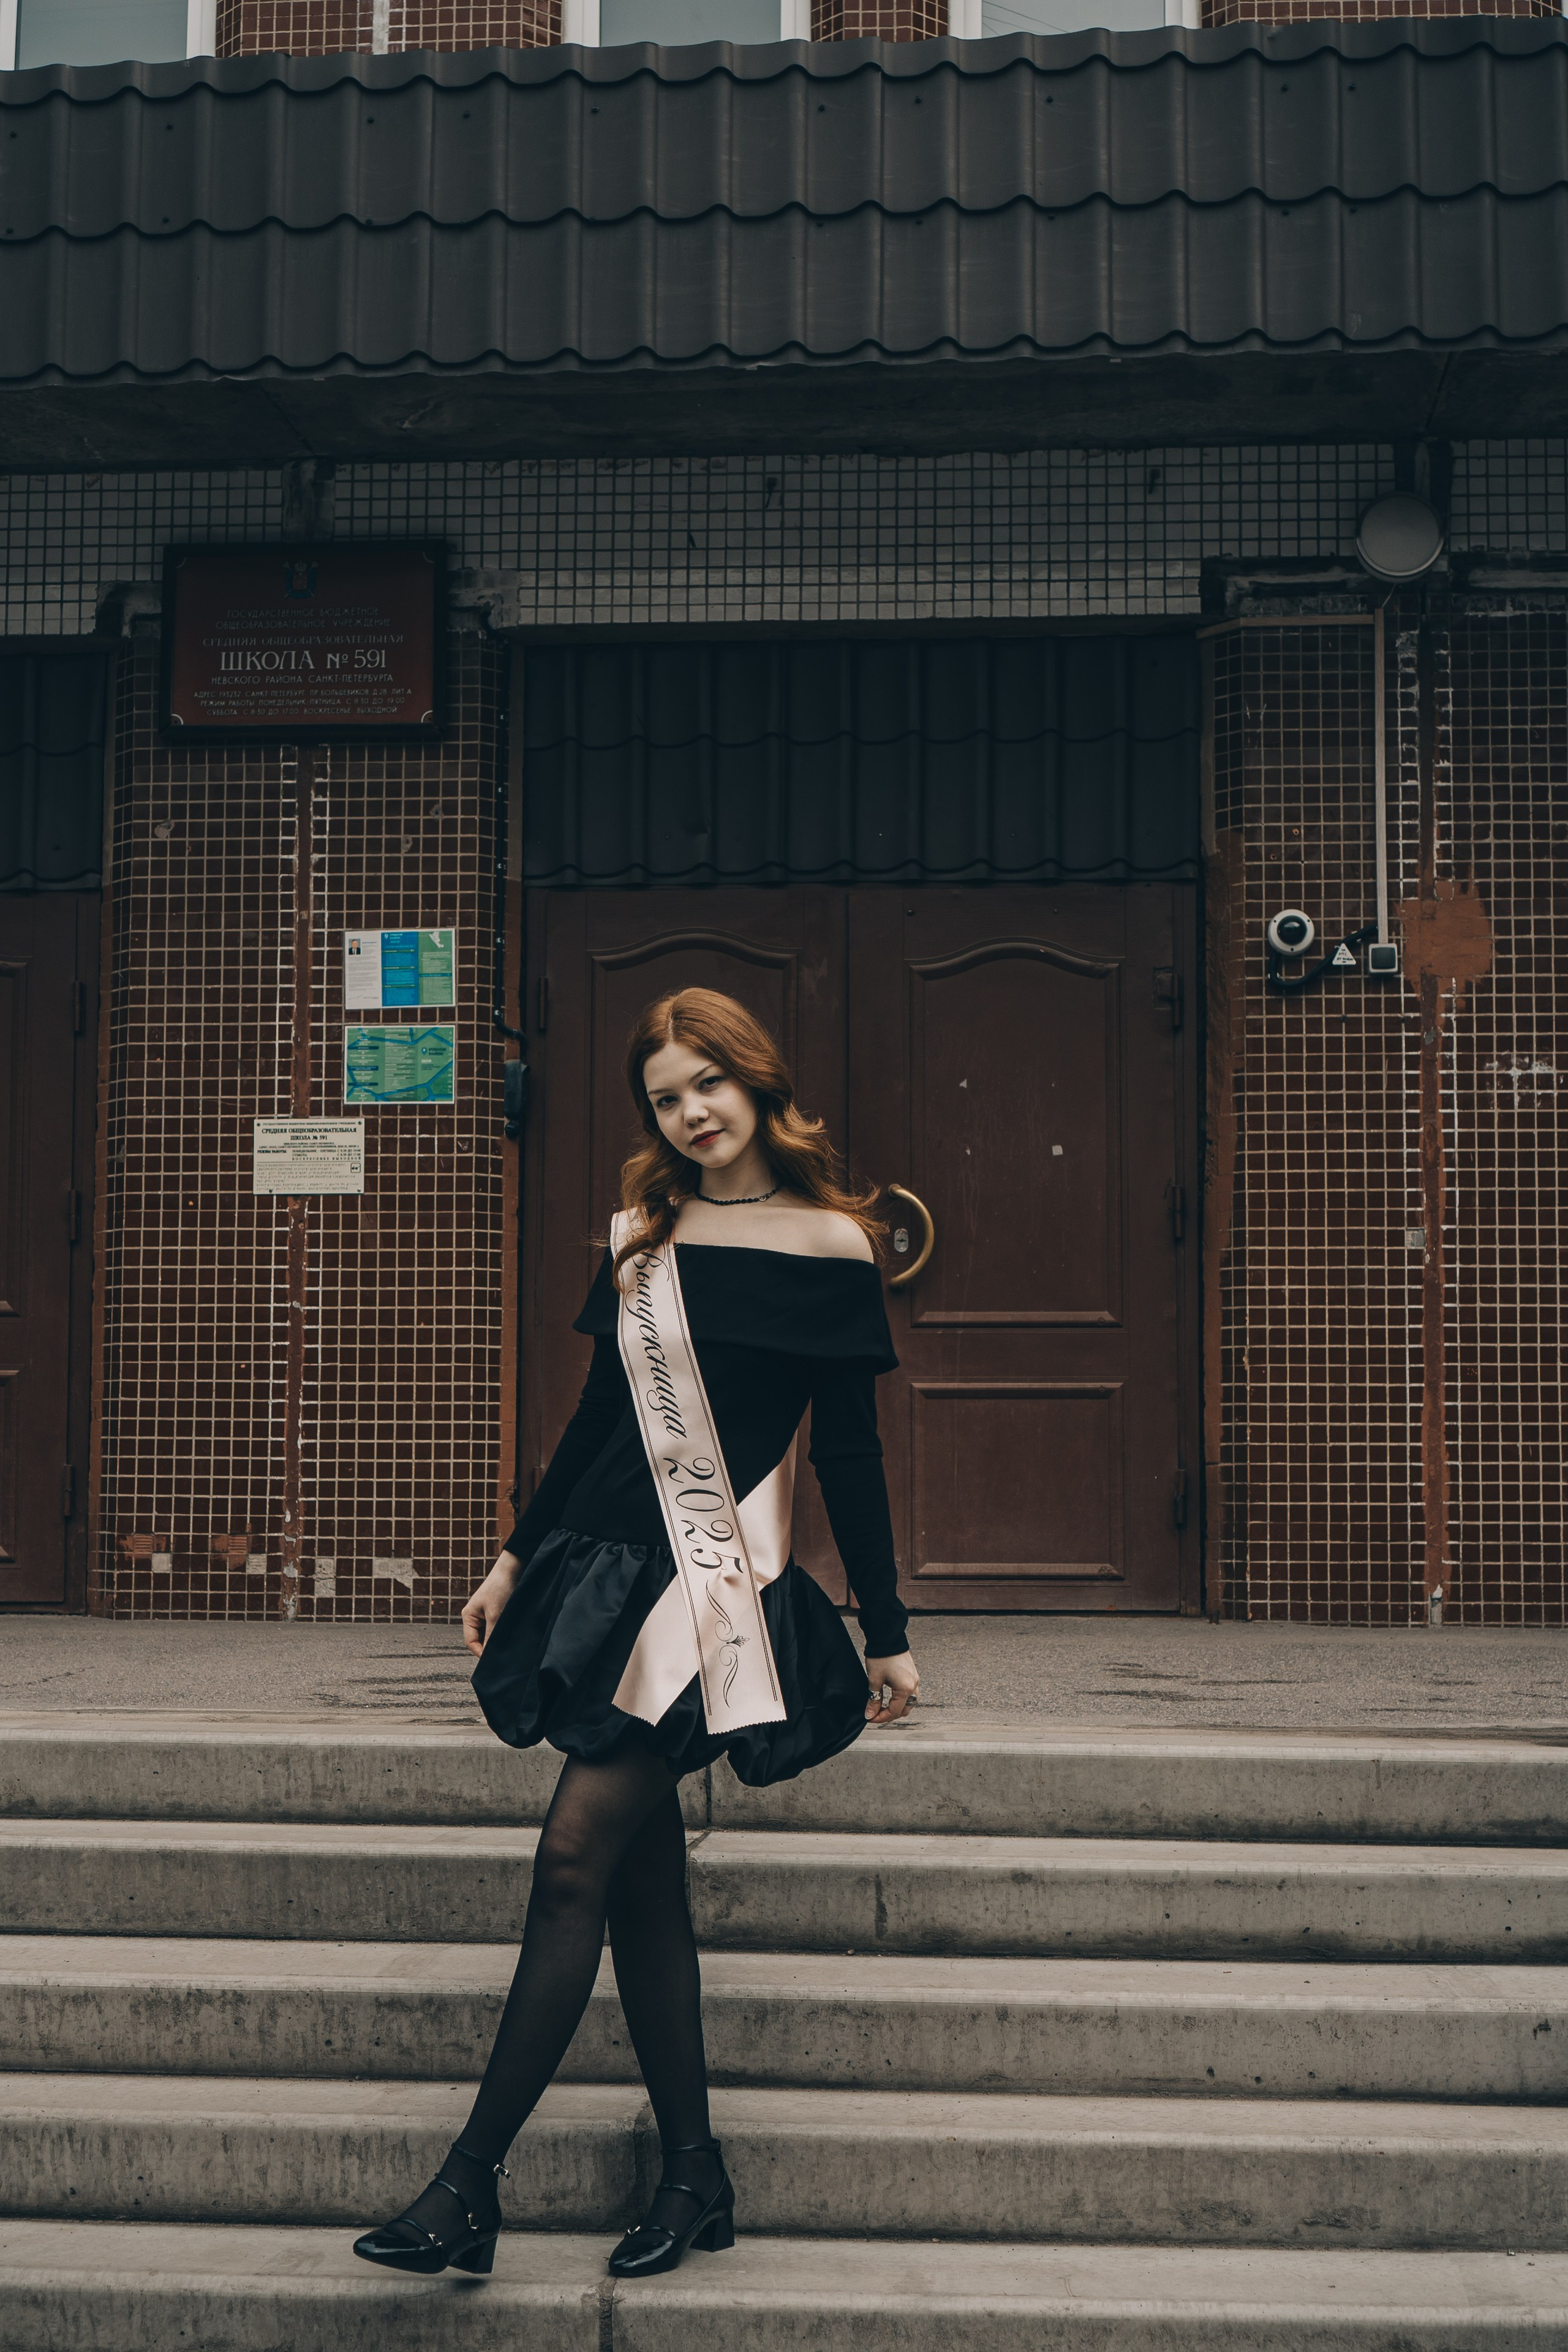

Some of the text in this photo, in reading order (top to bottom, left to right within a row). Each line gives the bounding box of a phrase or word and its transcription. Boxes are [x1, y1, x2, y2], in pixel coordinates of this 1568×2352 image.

[227, 607, 380, 618] ГОСУДАРСТВЕННОЕ БЮДЖЕТНОЕ
[216, 618, 392, 630] ОБЩЕОБРАЗОВАТЕЛЬНОЕ УЧРЕЖДЕНИЕ
[203, 635, 404, 646] СРЕДНЯЯ ОБЩЕОБРАЗОВАТЕЛЬНАЯ
[221, 650, 316, 671] ШКОЛА
[354, 649, 386, 668] 591
[211, 674, 393, 685] НЕВСКОГО РАЙОНА САНКТ-ПЕТЕРБУРГА
[625, 1238, 744, 1574] Выпускница 2025
